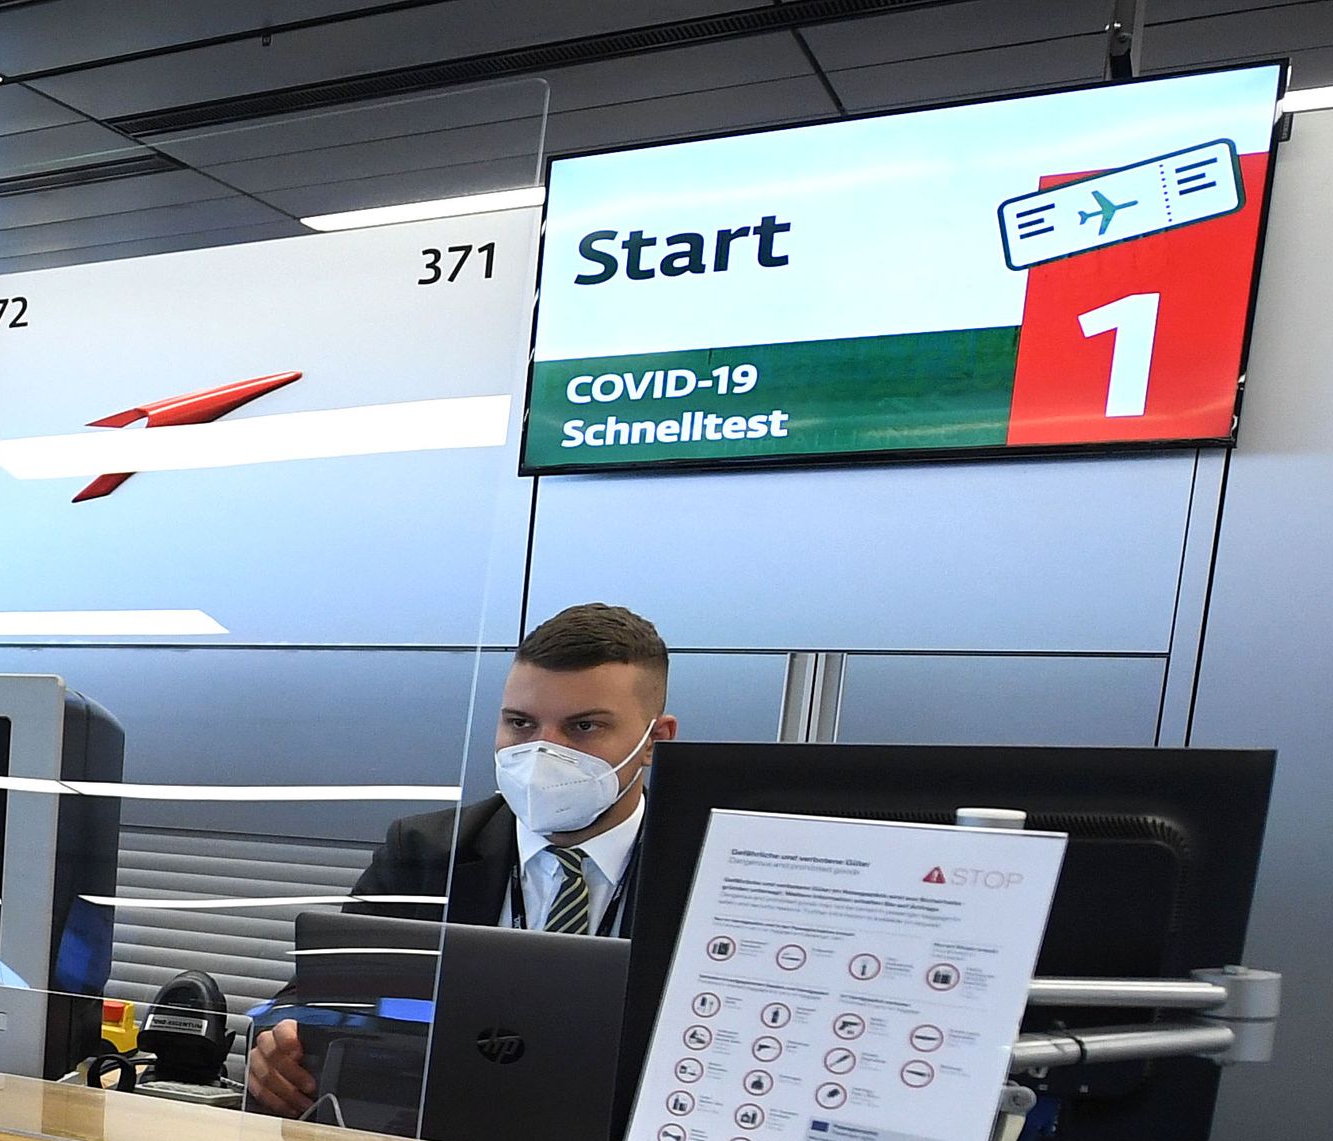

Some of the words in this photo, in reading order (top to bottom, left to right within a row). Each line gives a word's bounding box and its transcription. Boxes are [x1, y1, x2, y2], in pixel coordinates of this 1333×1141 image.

[417, 242, 497, 285] 371
[573, 214, 792, 287] Start
[1077, 291, 1161, 418] 1
[566, 364, 758, 404] COVID-19
[561, 410, 789, 449] Schnelltest
[951, 866, 1024, 890] STOP
